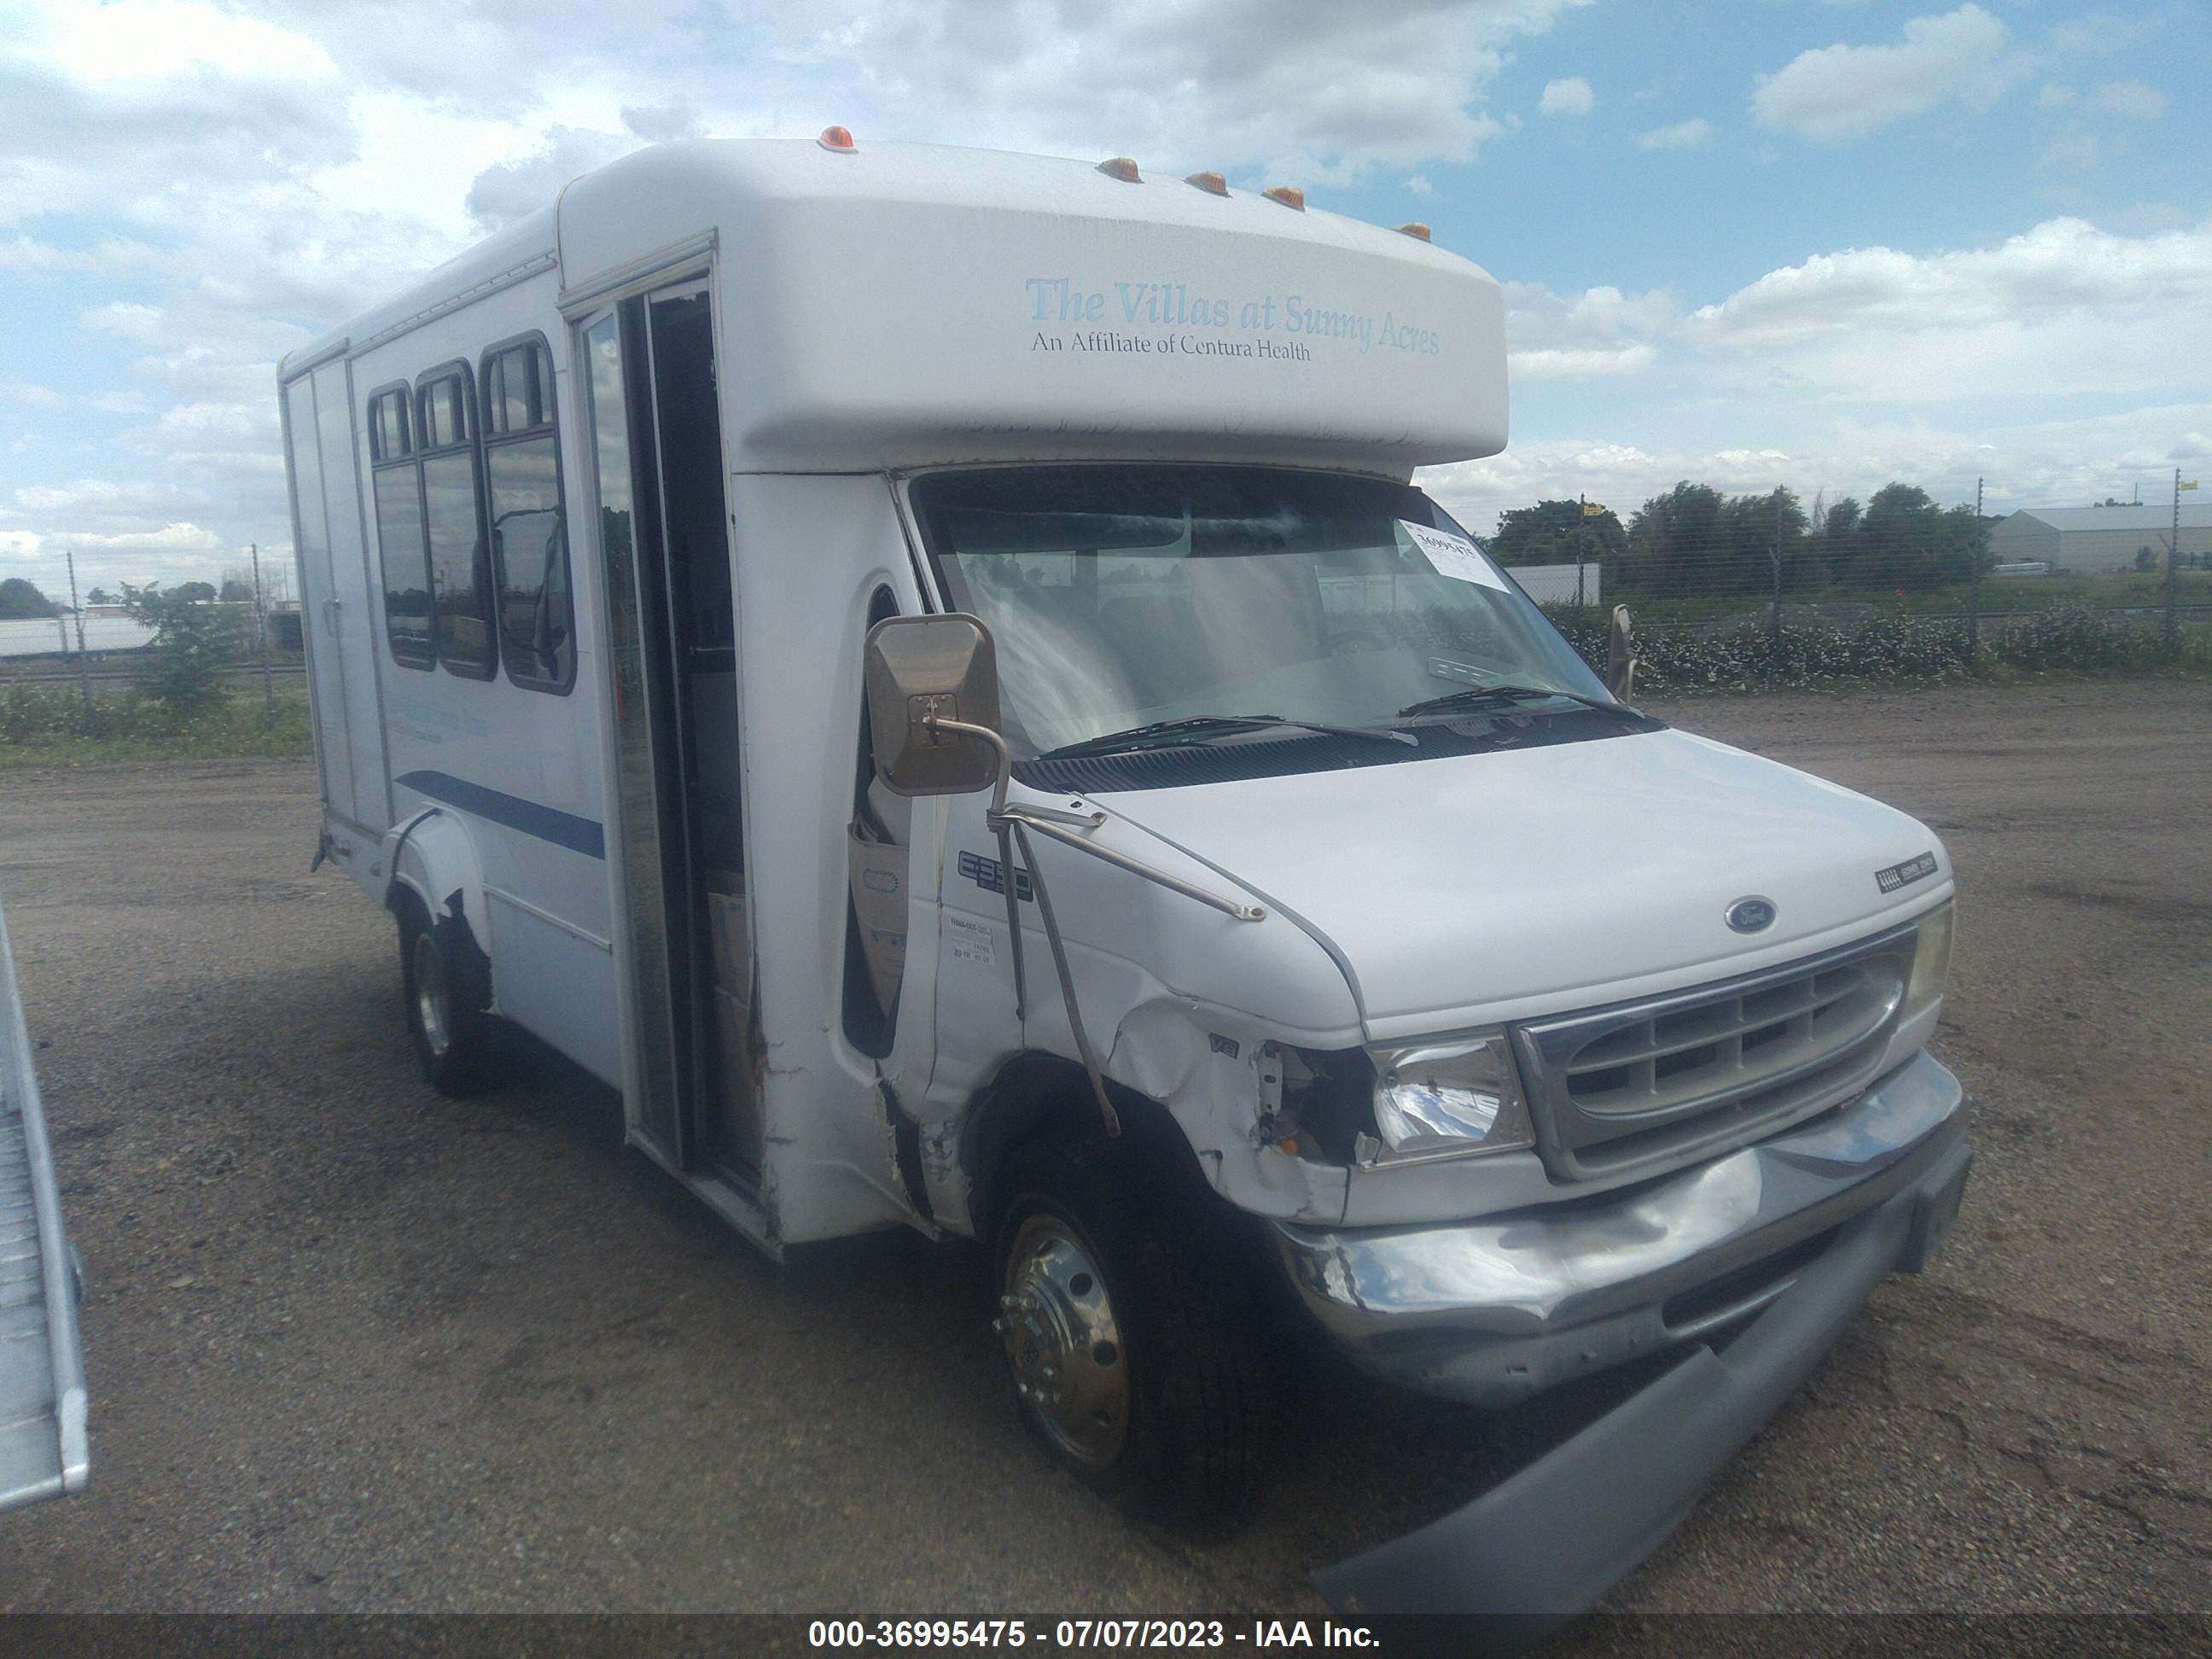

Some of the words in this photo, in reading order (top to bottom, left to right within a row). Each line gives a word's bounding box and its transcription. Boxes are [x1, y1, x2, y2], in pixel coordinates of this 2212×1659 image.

[1026, 278, 1105, 322] The
[1115, 282, 1230, 328] Villas
[1241, 295, 1276, 330] at
[1286, 295, 1372, 355] Sunny
[1379, 311, 1441, 356] Acres
[1031, 331, 1062, 351] An
[1071, 331, 1151, 353] Affiliate
[1157, 334, 1175, 353] of
[1181, 335, 1253, 358] Centura
[1256, 339, 1312, 362] Health
